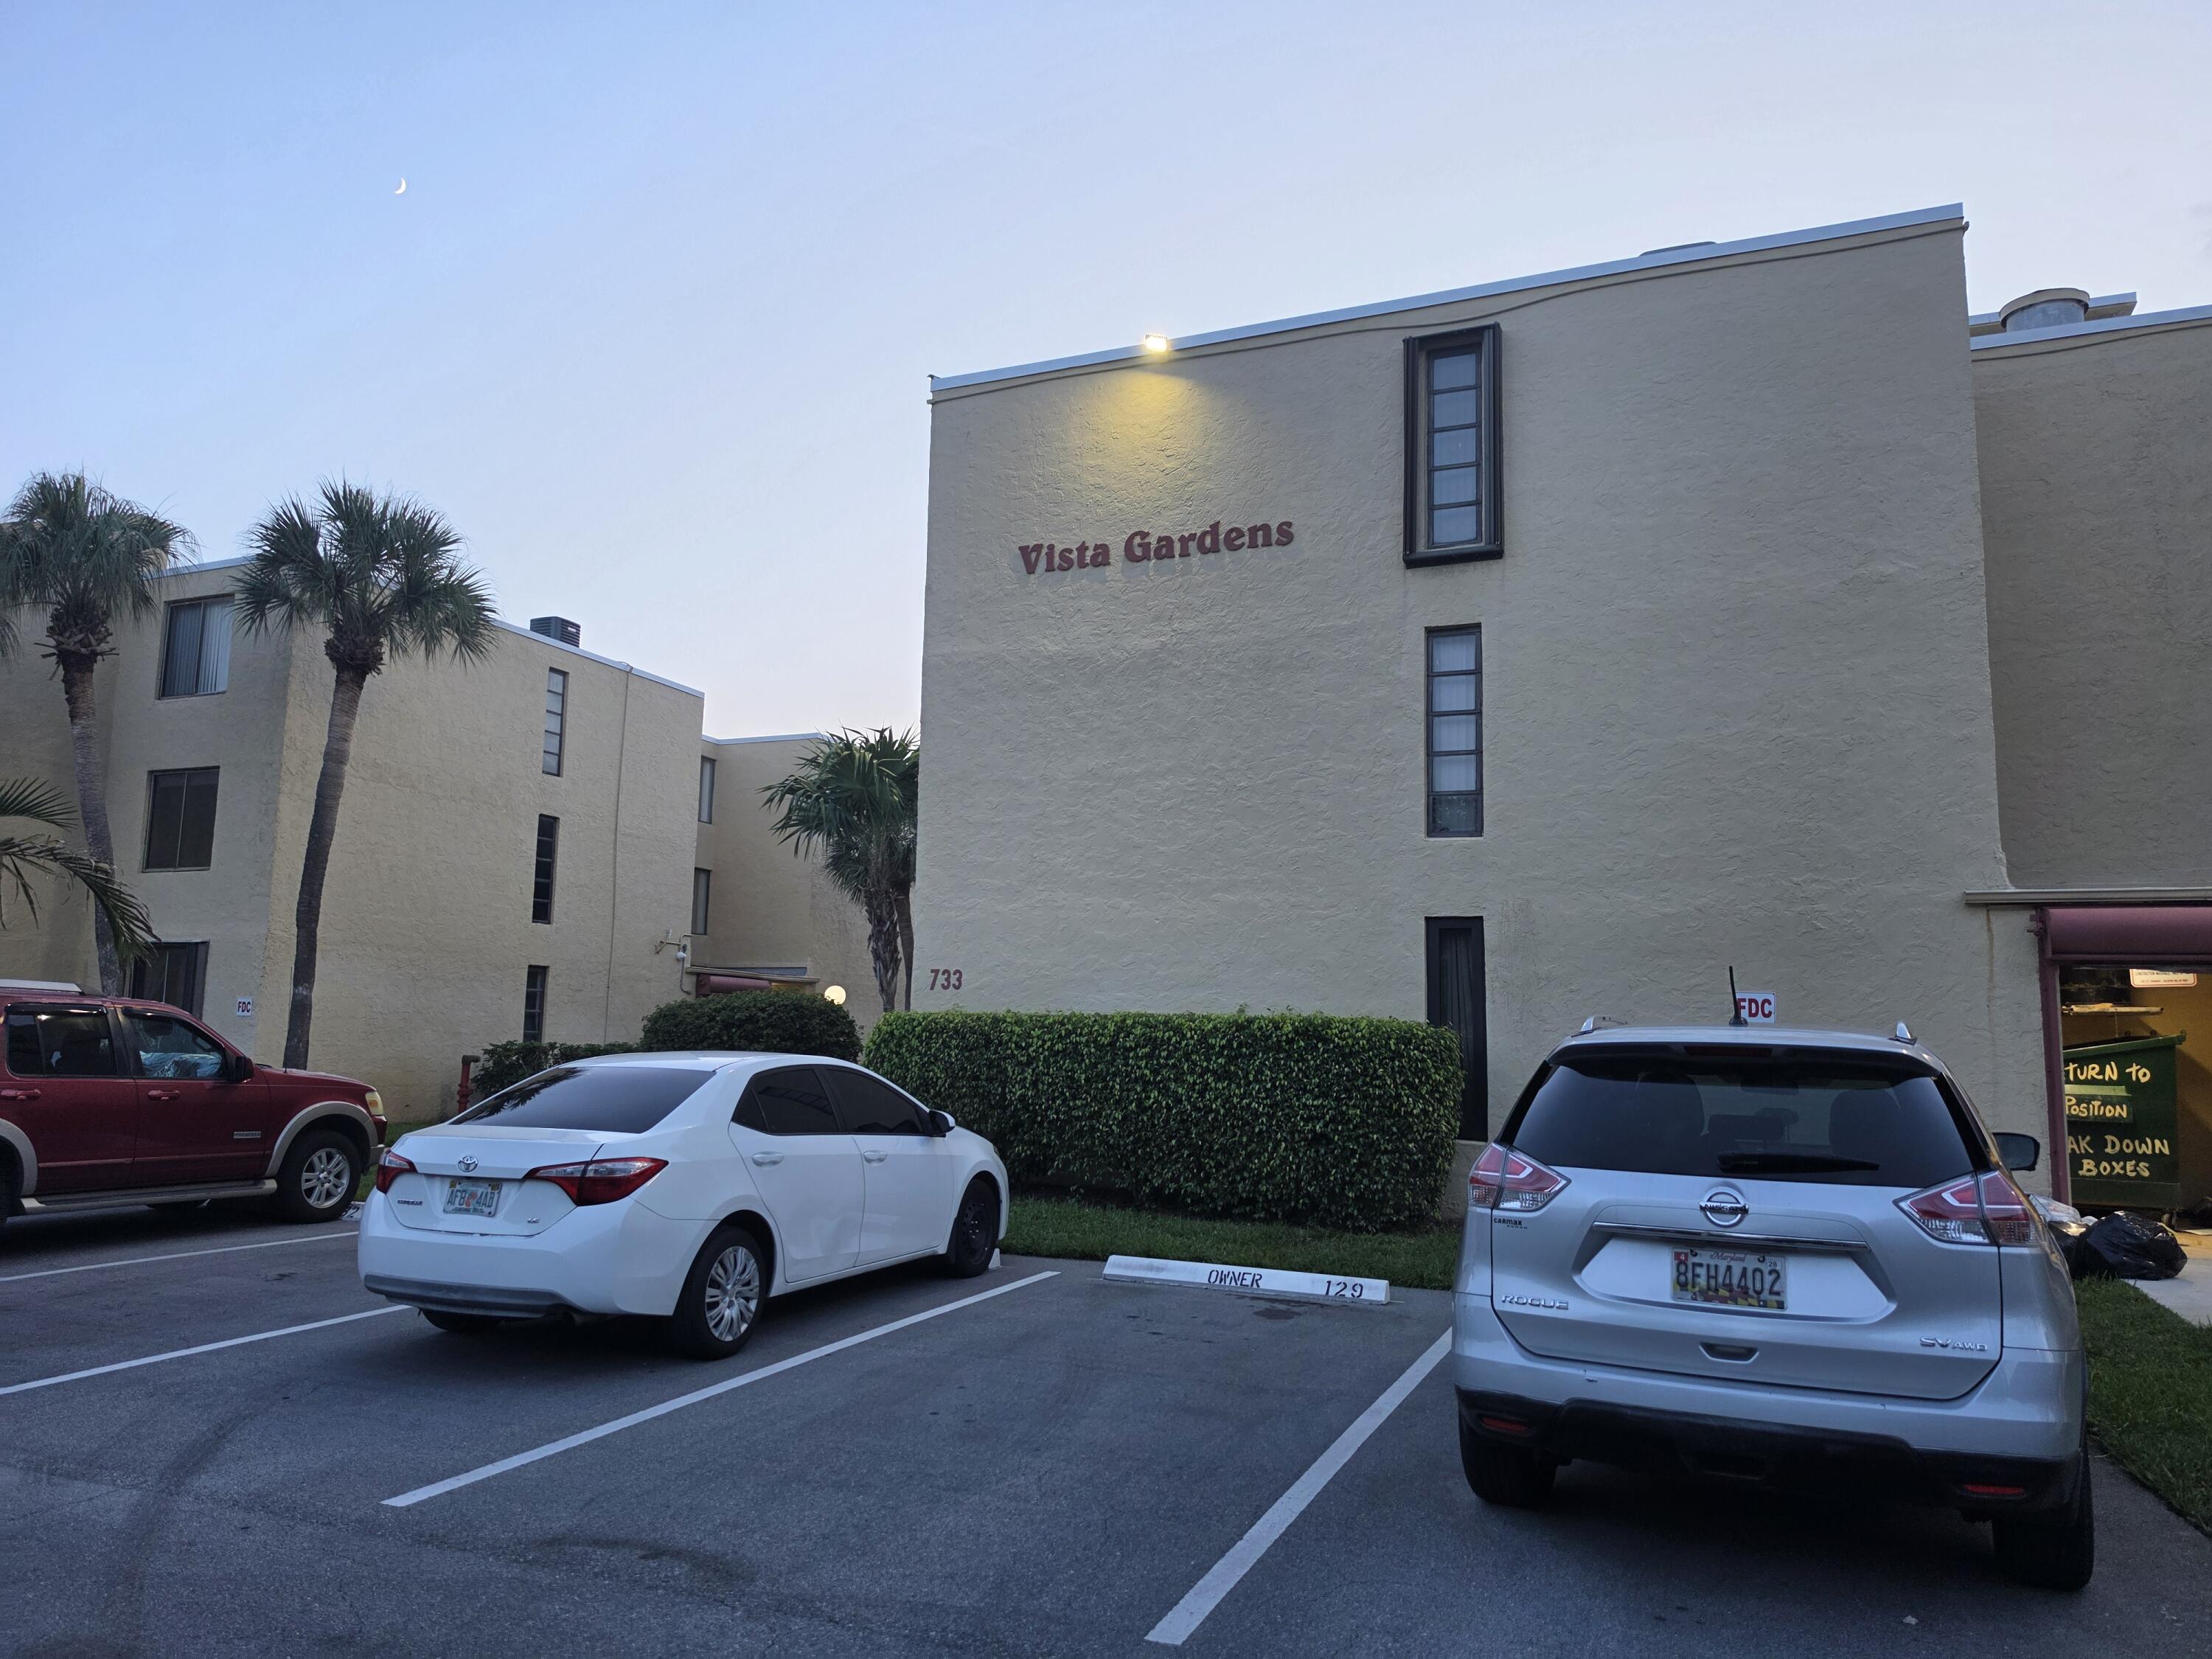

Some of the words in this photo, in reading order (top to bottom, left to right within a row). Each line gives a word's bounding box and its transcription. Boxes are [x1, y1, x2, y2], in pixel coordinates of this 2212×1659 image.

[1018, 540, 1110, 574] Vista
[1124, 521, 1294, 563] Gardens
[930, 969, 963, 990] 733
[237, 1001, 251, 1013] FDC
[1737, 998, 1773, 1018] FDC
[2063, 1062, 2118, 1082] TURN
[2104, 1135, 2171, 1155] DOWN
[2078, 1158, 2151, 1178] BOXES
[1710, 1253, 1747, 1263] Maryland
[1207, 1269, 1263, 1289] OWNER
[1325, 1280, 1364, 1298] 129
[1676, 1261, 1781, 1296] 8FH4402
[1501, 1294, 1570, 1310] ROGUE
[1919, 1336, 1952, 1348] SV
[1951, 1341, 1988, 1352] AWD
